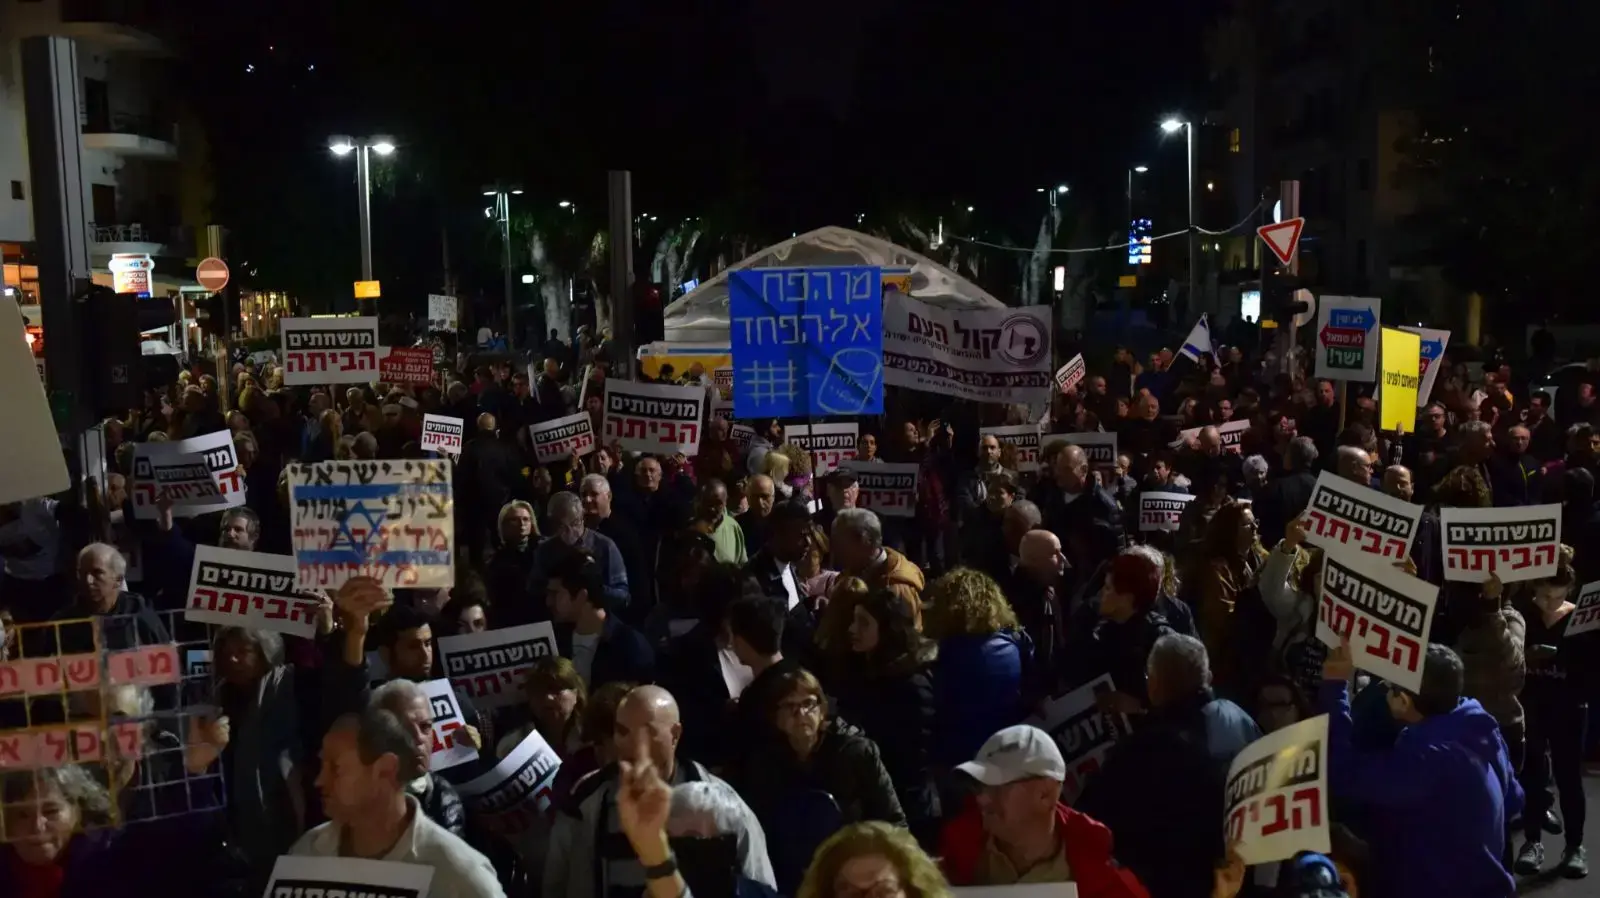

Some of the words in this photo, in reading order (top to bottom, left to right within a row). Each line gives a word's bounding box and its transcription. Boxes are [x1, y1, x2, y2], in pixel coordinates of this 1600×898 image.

[763, 271, 833, 304] הפח
[841, 270, 872, 305] מן
[908, 311, 948, 345] העם
[1351, 331, 1362, 344] לא
[288, 332, 372, 347] מושחתים
[954, 320, 1002, 359] קול
[287, 351, 375, 372] הביתה
[383, 362, 402, 372] נגד
[884, 354, 939, 374] להשפיע
[1329, 348, 1361, 365] ישר!
[380, 371, 430, 382] הממשלה
[405, 364, 430, 373] העם
[947, 366, 992, 387] להצביע
[1004, 371, 1049, 387] להציע
[611, 395, 697, 417] מושחתים
[426, 422, 461, 435] מושחתים
[535, 421, 589, 442] מושחתים
[606, 415, 697, 443] הביתה
[423, 433, 461, 447] הביתה
[537, 434, 593, 457] הביתה
[858, 474, 912, 487] מושחת
[860, 489, 911, 508] הבית
[1143, 500, 1186, 510] ושחתים
[1142, 511, 1180, 524] ביתה
[1317, 490, 1411, 536] מושחתים
[1303, 511, 1407, 560] הביתה
[1450, 523, 1553, 542] מושחתים
[1448, 544, 1556, 573] הביתה
[202, 565, 297, 593] ושחתים
[193, 588, 316, 625] הביתה
[1326, 564, 1422, 630] מושחתים
[1320, 593, 1421, 673] הביתה
[448, 642, 550, 673] מושחתים
